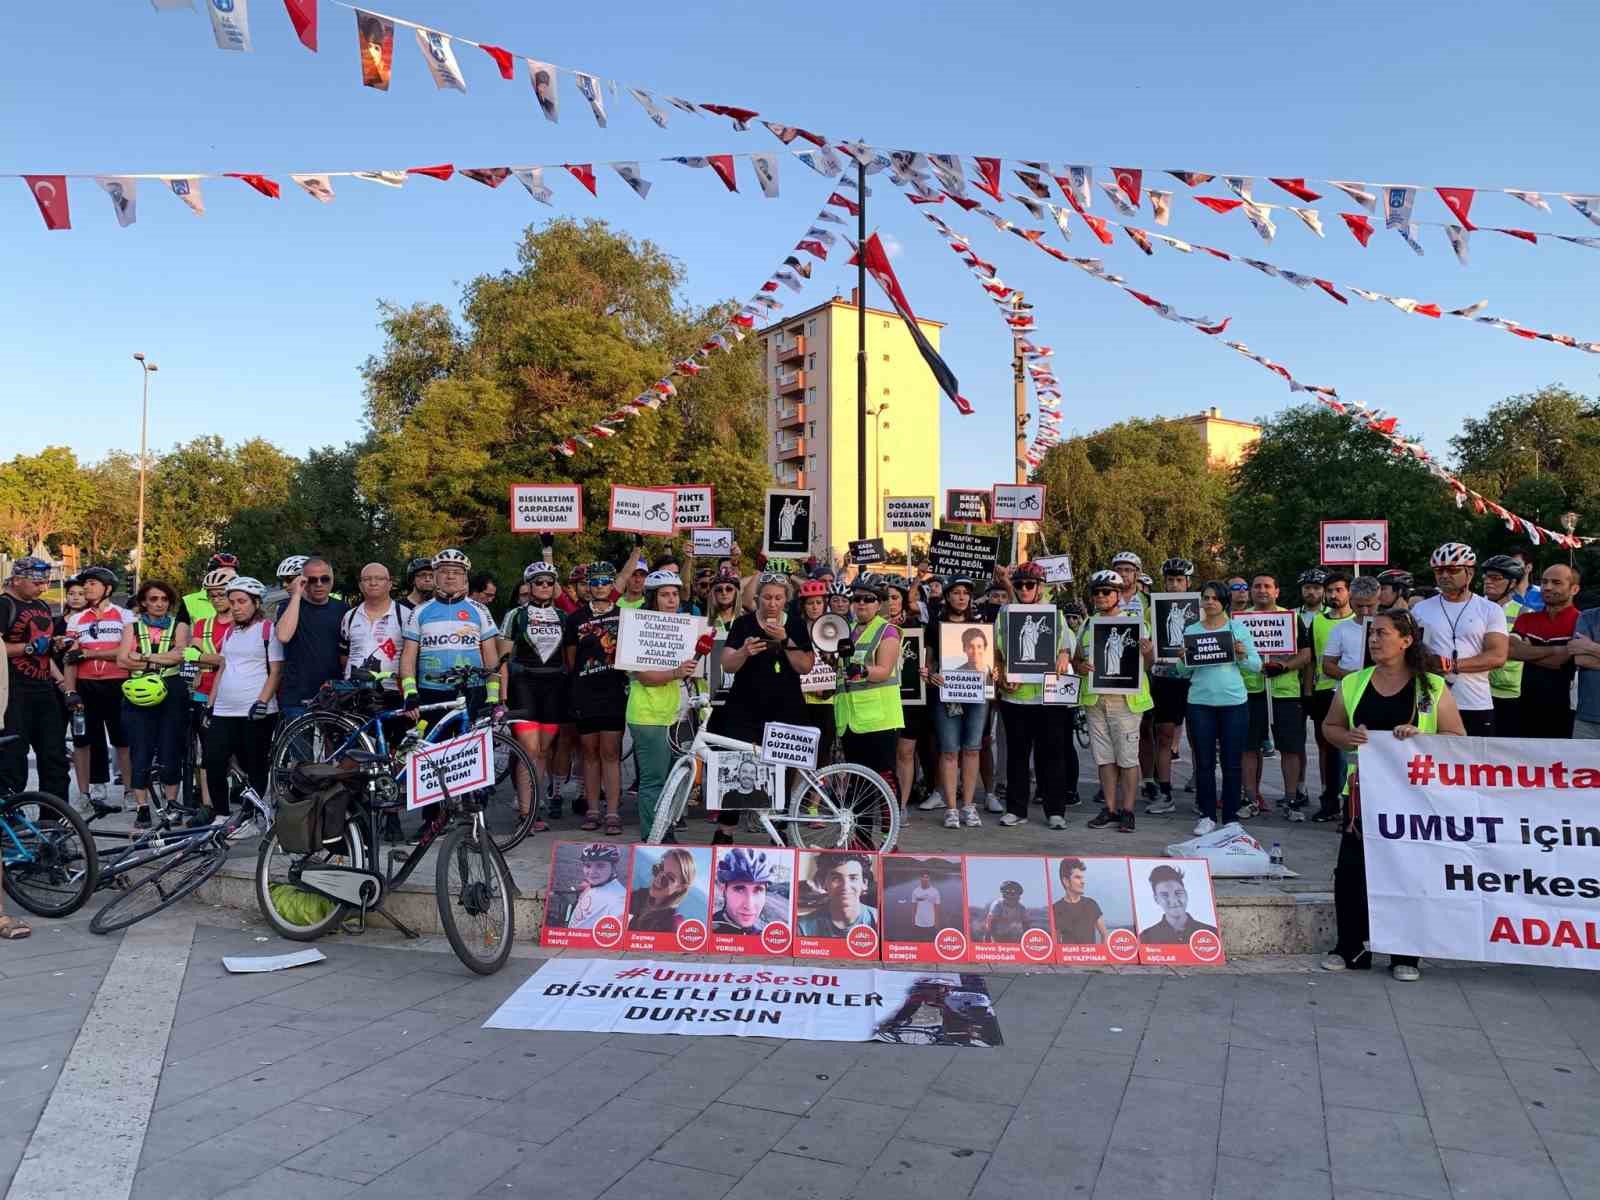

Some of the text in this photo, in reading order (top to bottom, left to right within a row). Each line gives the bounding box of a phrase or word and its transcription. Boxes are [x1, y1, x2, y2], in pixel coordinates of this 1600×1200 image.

[888, 501, 931, 510] DOĞANAY
[886, 510, 932, 519] GÜZELGÜN
[892, 520, 926, 528] BURADA
[937, 540, 991, 553] ALKOLLÜ OLARAK
[974, 553, 996, 561] OLMAK
[939, 557, 984, 569] KAZA DEĞİL
[530, 627, 560, 635] DELTA
[421, 633, 476, 647] ANGORA
[638, 639, 667, 649] YAŞAM
[1196, 637, 1218, 645] KAZA
[1198, 644, 1221, 652] DEĞİL
[645, 649, 678, 658] ADALET
[944, 674, 981, 682] DOĞANAY
[943, 682, 983, 690] GÜZELGÜN
[947, 690, 978, 698] BURADA
[770, 730, 815, 745] DOĞANAY
[767, 739, 815, 755] GÜZELGÜN
[771, 750, 808, 763] BURADA
[425, 769, 472, 790] ÖLRÜM!
[1378, 813, 1600, 852] UMUT için
[1445, 864, 1600, 899] Herkes
[543, 981, 883, 1007] BİSİKLETLİ ÖLÜMLER
[624, 1006, 782, 1024] DUR!SUN
